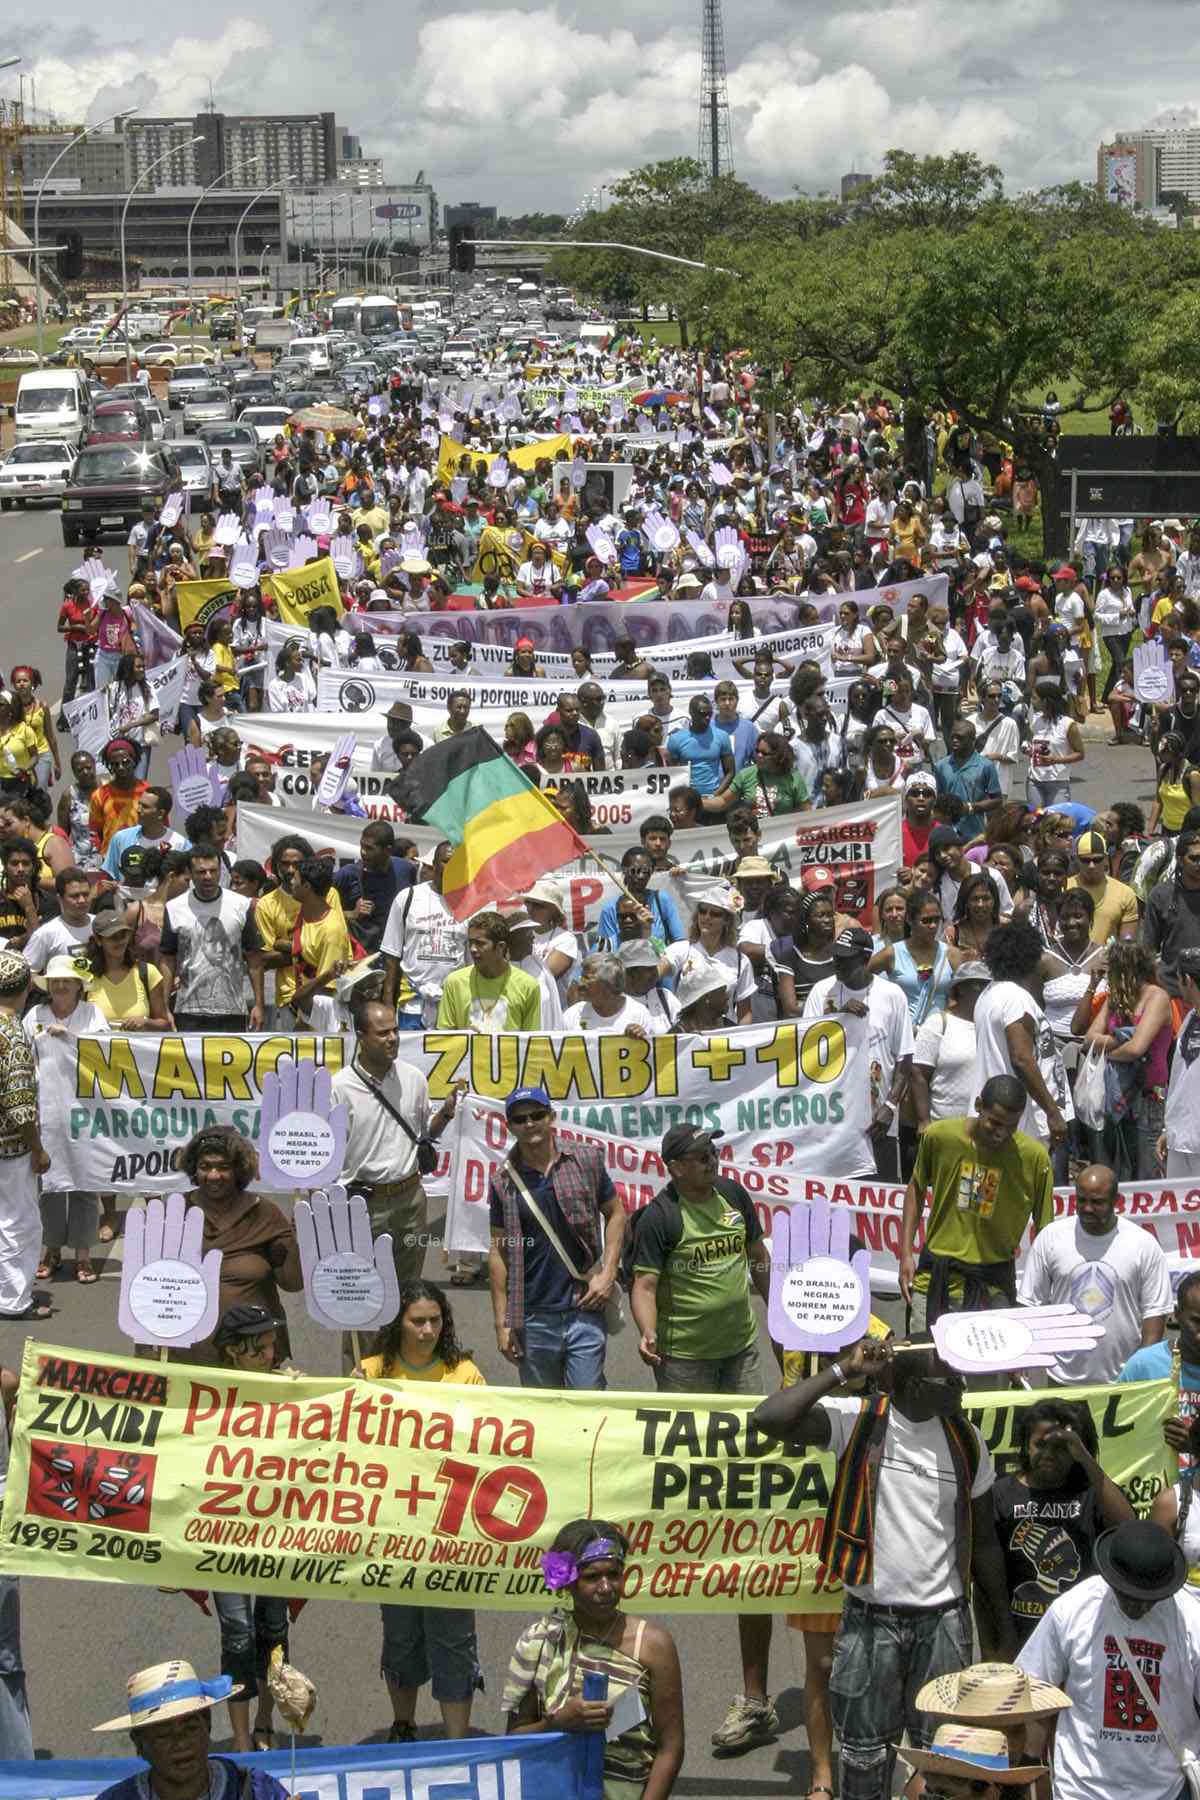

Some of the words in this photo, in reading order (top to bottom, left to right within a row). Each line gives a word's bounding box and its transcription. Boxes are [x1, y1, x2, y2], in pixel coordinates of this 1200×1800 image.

[397, 206, 417, 217] TIM
[480, 689, 525, 708] porque
[647, 773, 671, 794] SP
[590, 804, 633, 825] 2005
[76, 1036, 345, 1100] MARCH
[737, 1090, 845, 1132] NEGROS
[693, 1234, 742, 1267] AFRIC
[803, 1291, 841, 1299] NEGRAS
[806, 1280, 841, 1289] BRASIL,
[843, 1281, 855, 1289] AS
[787, 1301, 827, 1310] MORREM
[832, 1303, 855, 1311] MAIS
[814, 1313, 845, 1322] PARTO
[37, 1357, 168, 1407] MARCHA
[182, 1380, 454, 1452] Planaltina
[467, 1416, 536, 1459] na
[205, 1444, 389, 1490] Marcha
[198, 1481, 382, 1528] ZUMBI
[9, 1520, 79, 1553] 1995
[86, 1532, 163, 1564] 2005
[184, 1518, 260, 1548] CONTRA
[262, 1525, 277, 1549] O
[279, 1526, 363, 1556] RACISMO
[367, 1532, 380, 1558] E
[382, 1533, 427, 1563] PELO
[429, 1538, 493, 1568] DIREITO
[496, 1543, 508, 1568] A
[514, 1546, 547, 1570] VID
[659, 1516, 759, 1559] 30/10
[195, 1549, 286, 1580] ZUMBI
[290, 1557, 349, 1586] VIVE,
[361, 1563, 393, 1588] SE
[400, 1566, 417, 1590] A
[425, 1569, 500, 1595] GENTE
